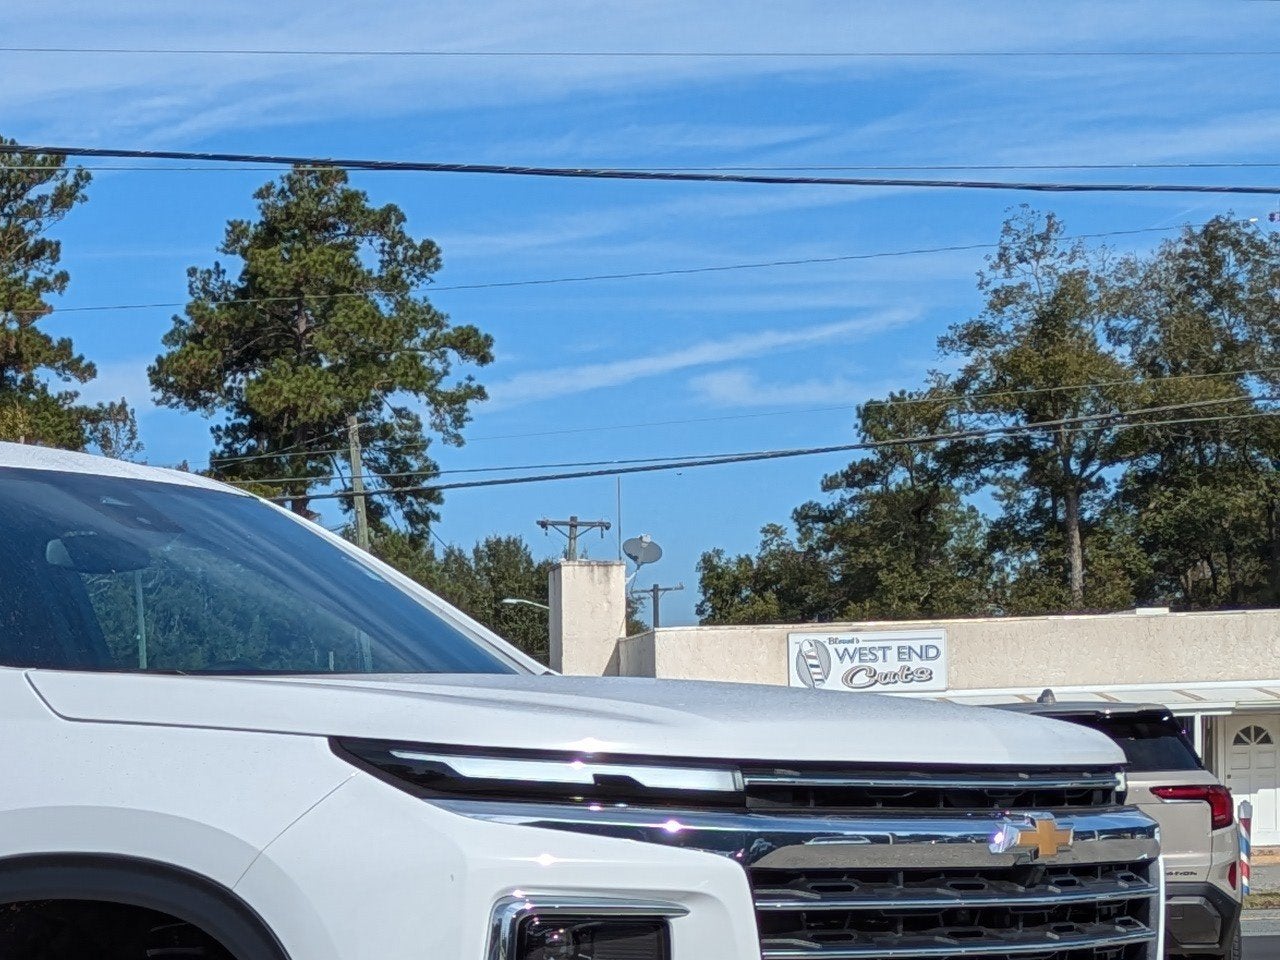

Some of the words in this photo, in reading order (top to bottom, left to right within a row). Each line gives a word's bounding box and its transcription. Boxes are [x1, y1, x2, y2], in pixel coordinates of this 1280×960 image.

[835, 645, 892, 664] WEST
[897, 644, 941, 662] END
[841, 665, 933, 689] Cuts
